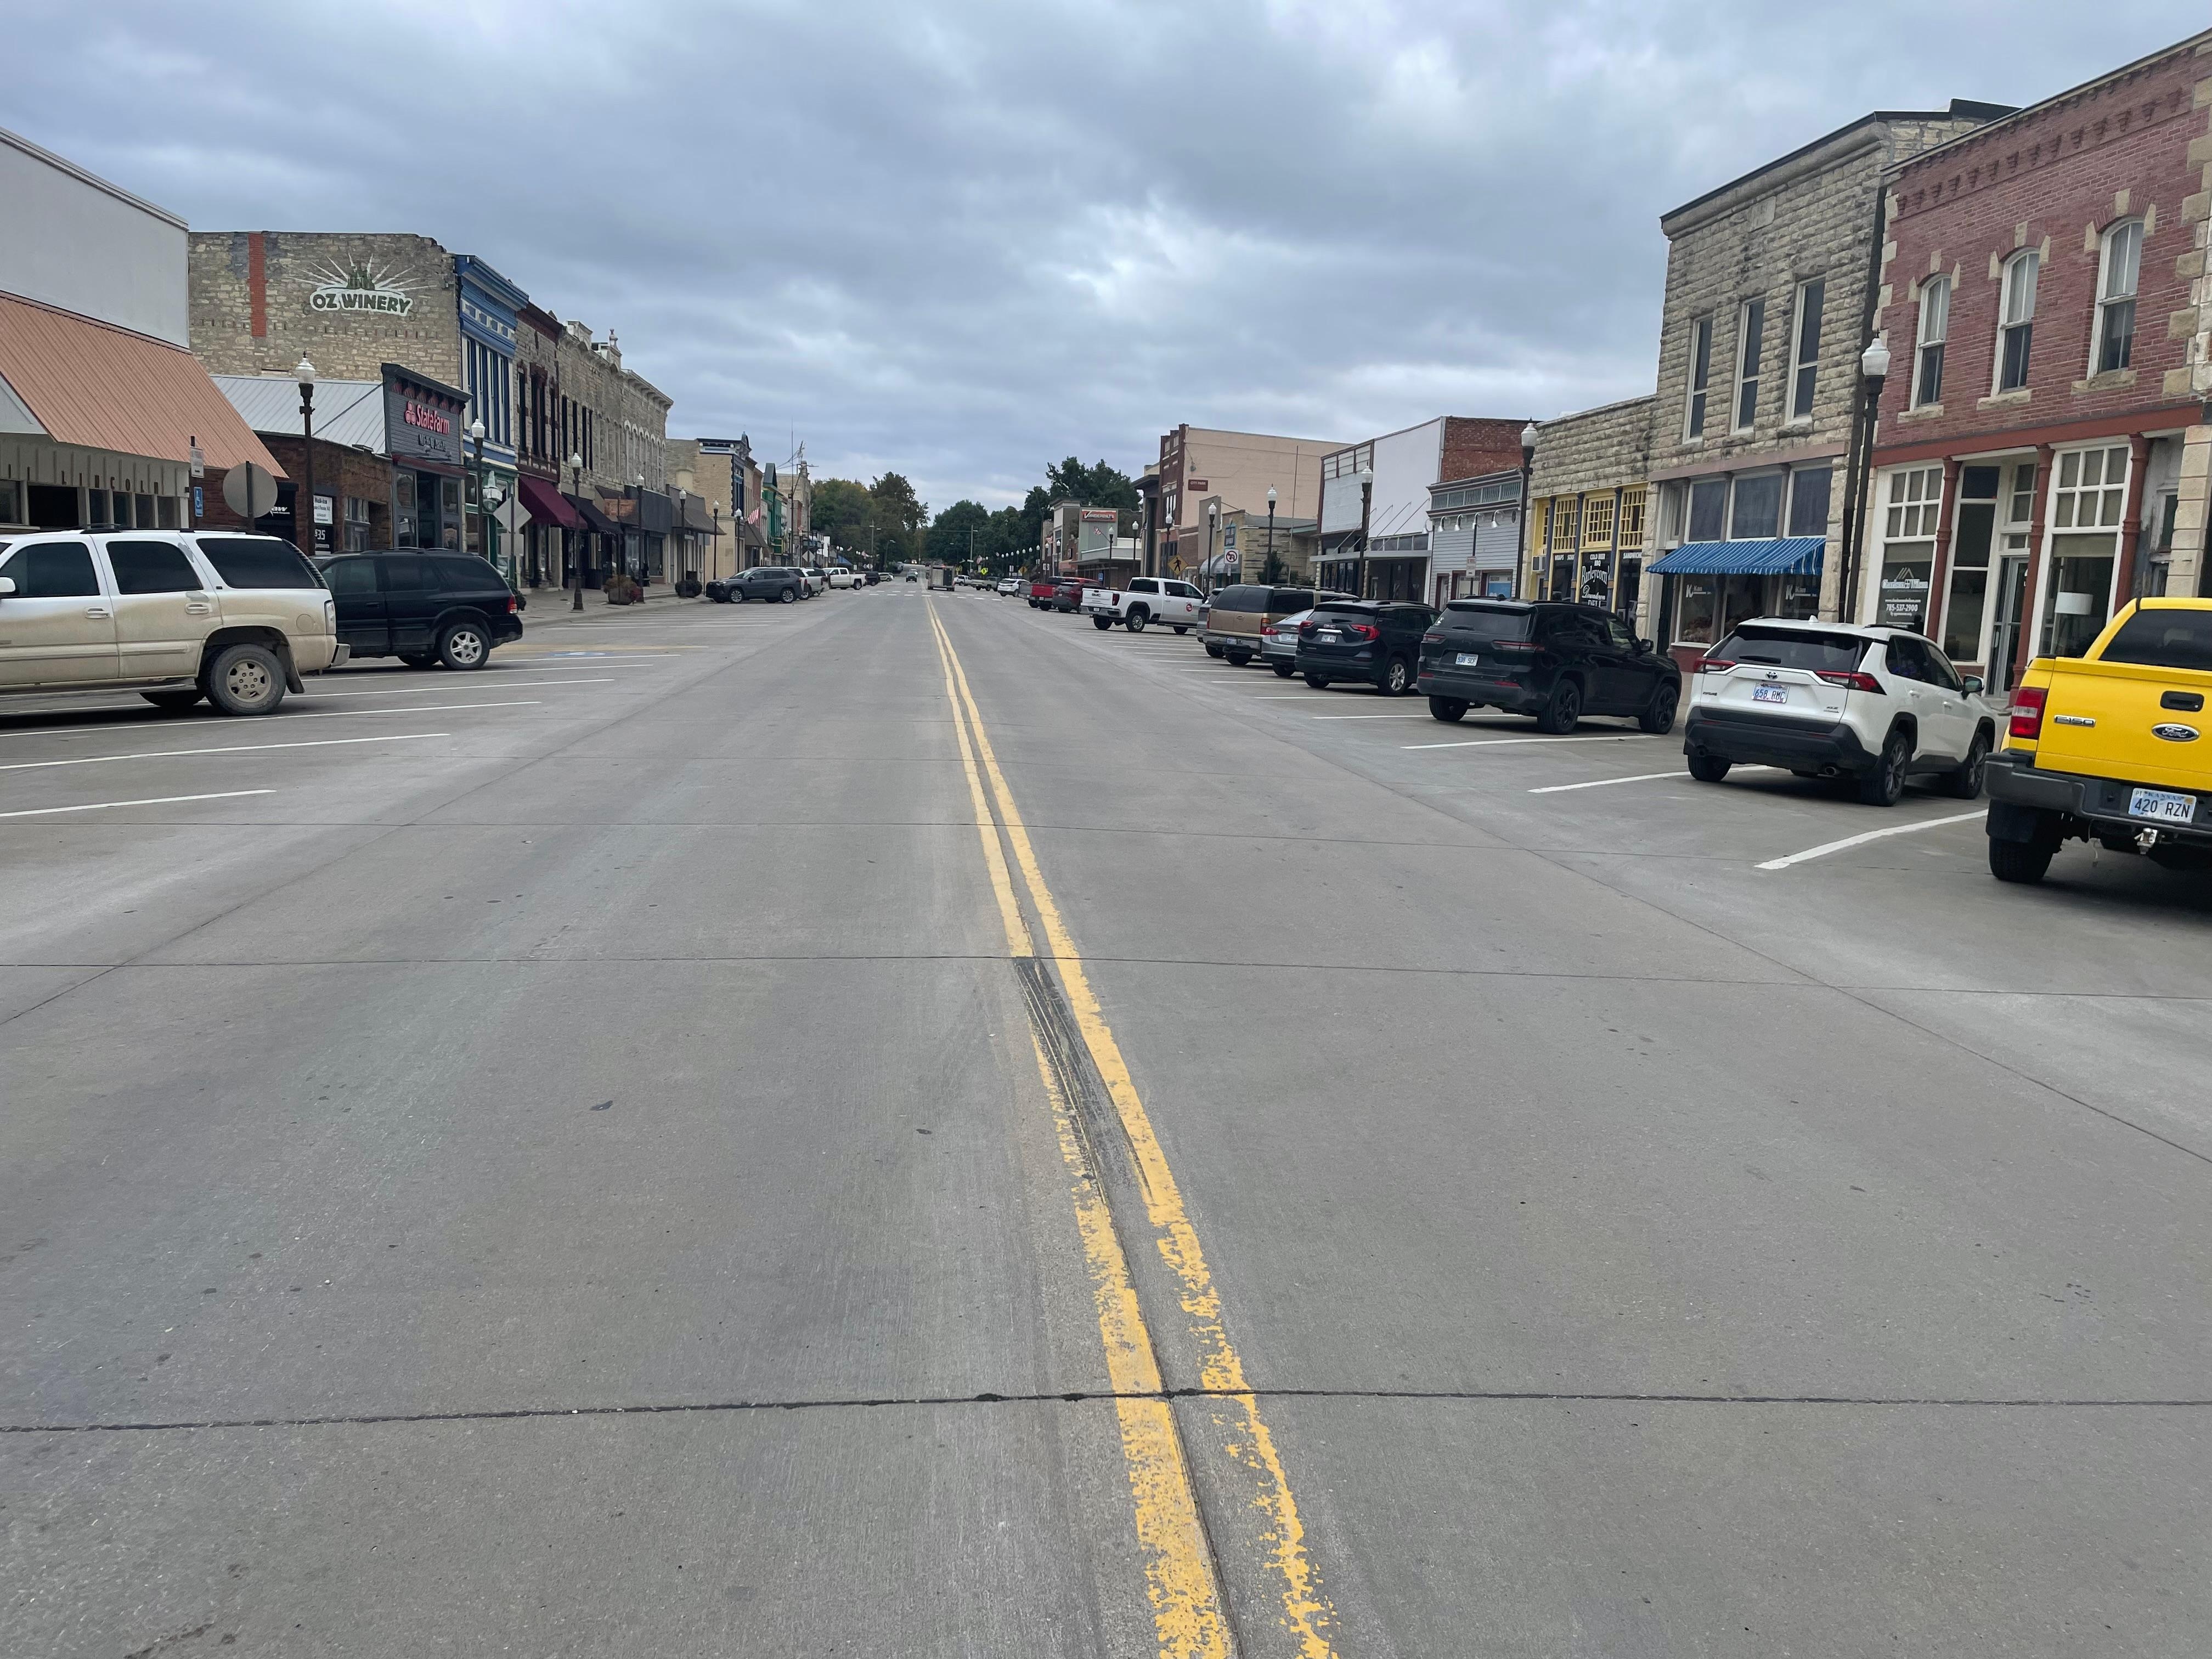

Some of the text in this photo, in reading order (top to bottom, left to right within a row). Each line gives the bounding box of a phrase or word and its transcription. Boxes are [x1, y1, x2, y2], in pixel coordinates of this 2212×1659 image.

[313, 294, 410, 313] OZ WINERY
[1581, 565, 1610, 589] Barleycorn'
[1755, 690, 1785, 700] 658 RMC
[2162, 726, 2189, 738] Ford
[2135, 798, 2190, 818] 420 RZN
